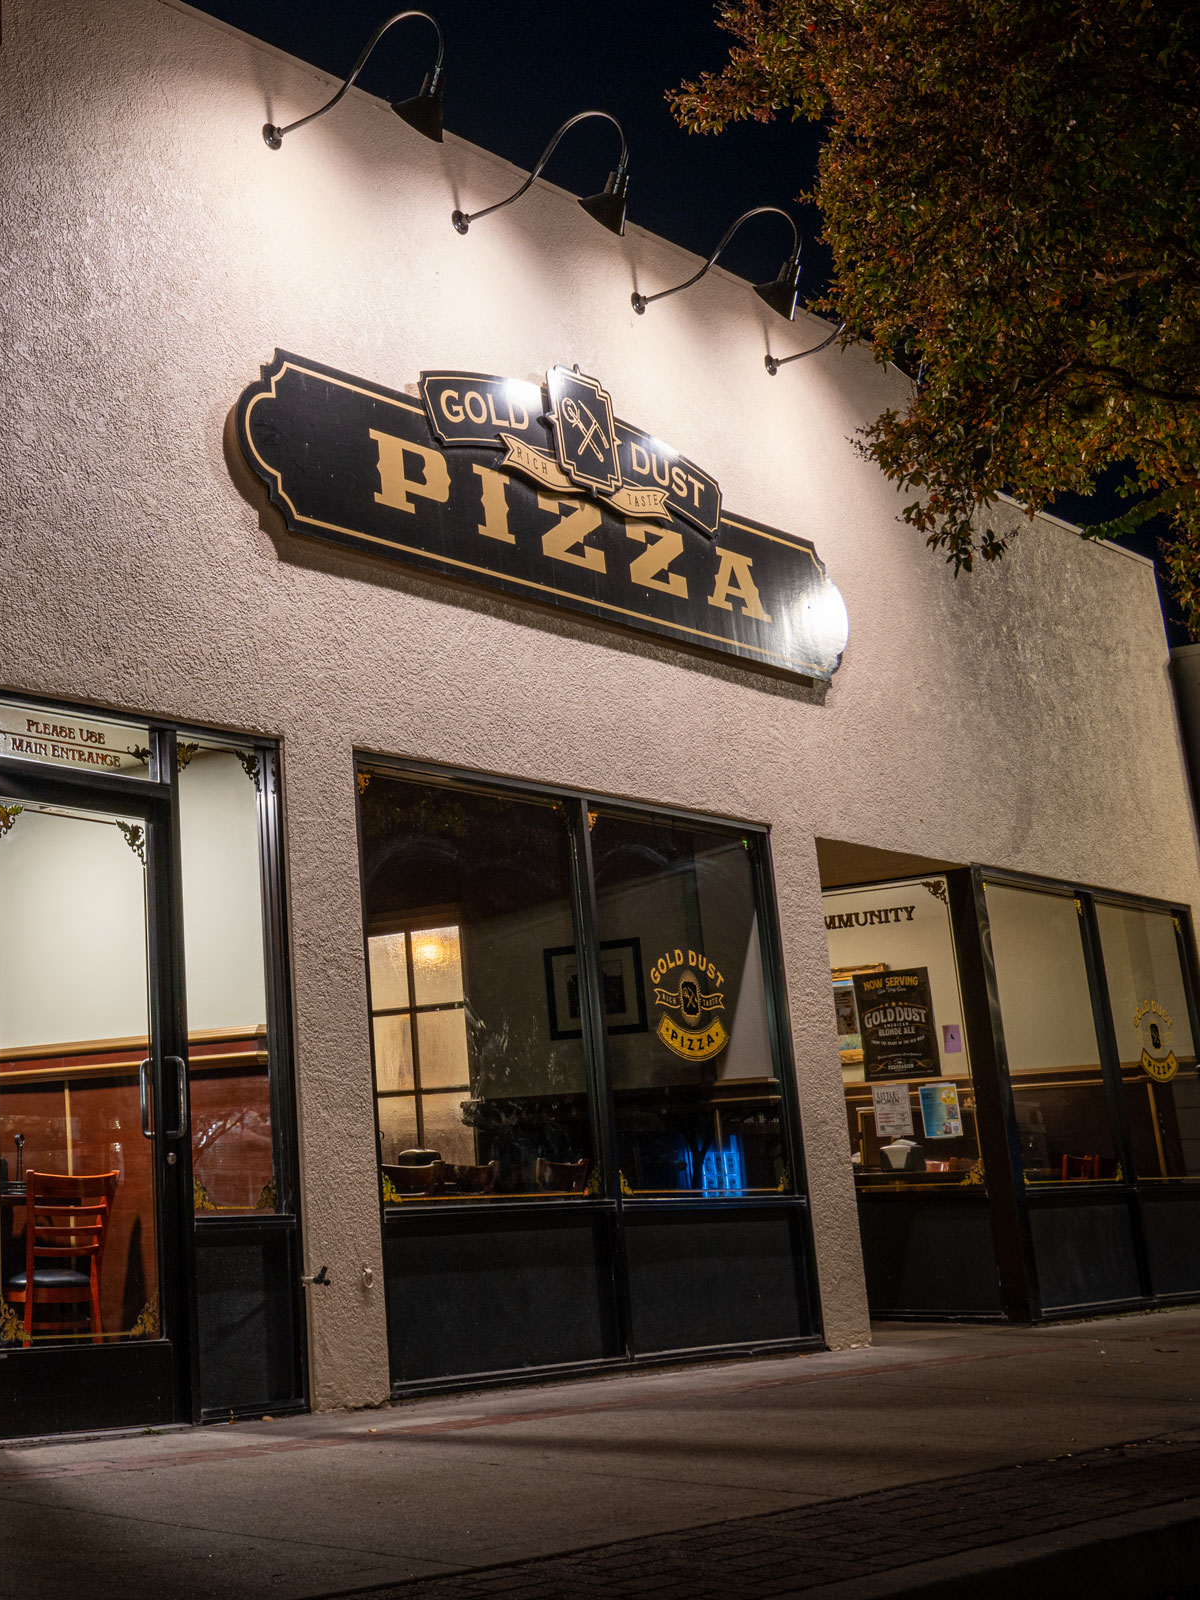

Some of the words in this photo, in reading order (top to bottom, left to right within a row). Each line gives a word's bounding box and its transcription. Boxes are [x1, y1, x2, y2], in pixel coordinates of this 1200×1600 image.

[440, 387, 530, 431] GOLD
[631, 444, 705, 509] DUST
[515, 445, 550, 476] RICH
[626, 491, 660, 508] TASTE
[368, 428, 773, 623] PIZZA
[26, 719, 76, 740] PLEASE
[78, 728, 106, 745] USE
[11, 737, 48, 757] MAIN
[50, 744, 121, 768] ENTRANCE
[650, 949, 684, 984] GOLD
[688, 949, 725, 988] DUST
[863, 978, 883, 991] NOW
[884, 975, 919, 987] SERVING
[864, 1008, 895, 1029] GOLD
[895, 1006, 926, 1023] DUST
[670, 1030, 715, 1051] PIZZA
[878, 1027, 902, 1037] BLONDE
[903, 1026, 916, 1034] ALE
[1147, 1060, 1171, 1075] PIZZA
[875, 1097, 900, 1105] WOMEN
[876, 1091, 897, 1100] LITTLE
